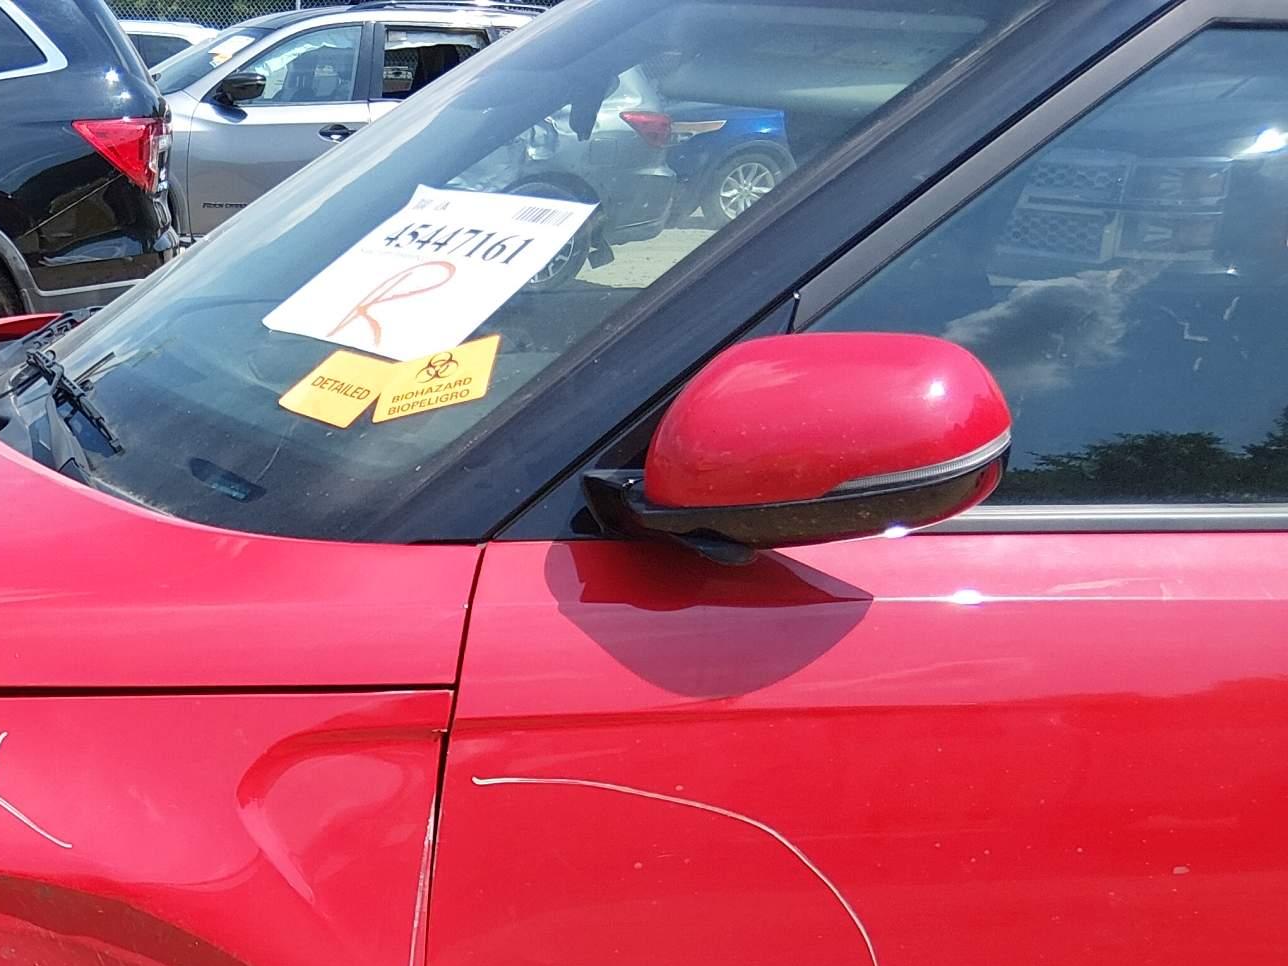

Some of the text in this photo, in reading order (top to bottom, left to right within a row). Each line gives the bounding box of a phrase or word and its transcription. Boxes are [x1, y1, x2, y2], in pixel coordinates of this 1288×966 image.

[384, 222, 535, 265] 45447161
[326, 260, 457, 348] R
[311, 375, 371, 401] DETAILED
[387, 388, 471, 416] BIOPELIGRO
[391, 377, 473, 404] BIOHAZARD
